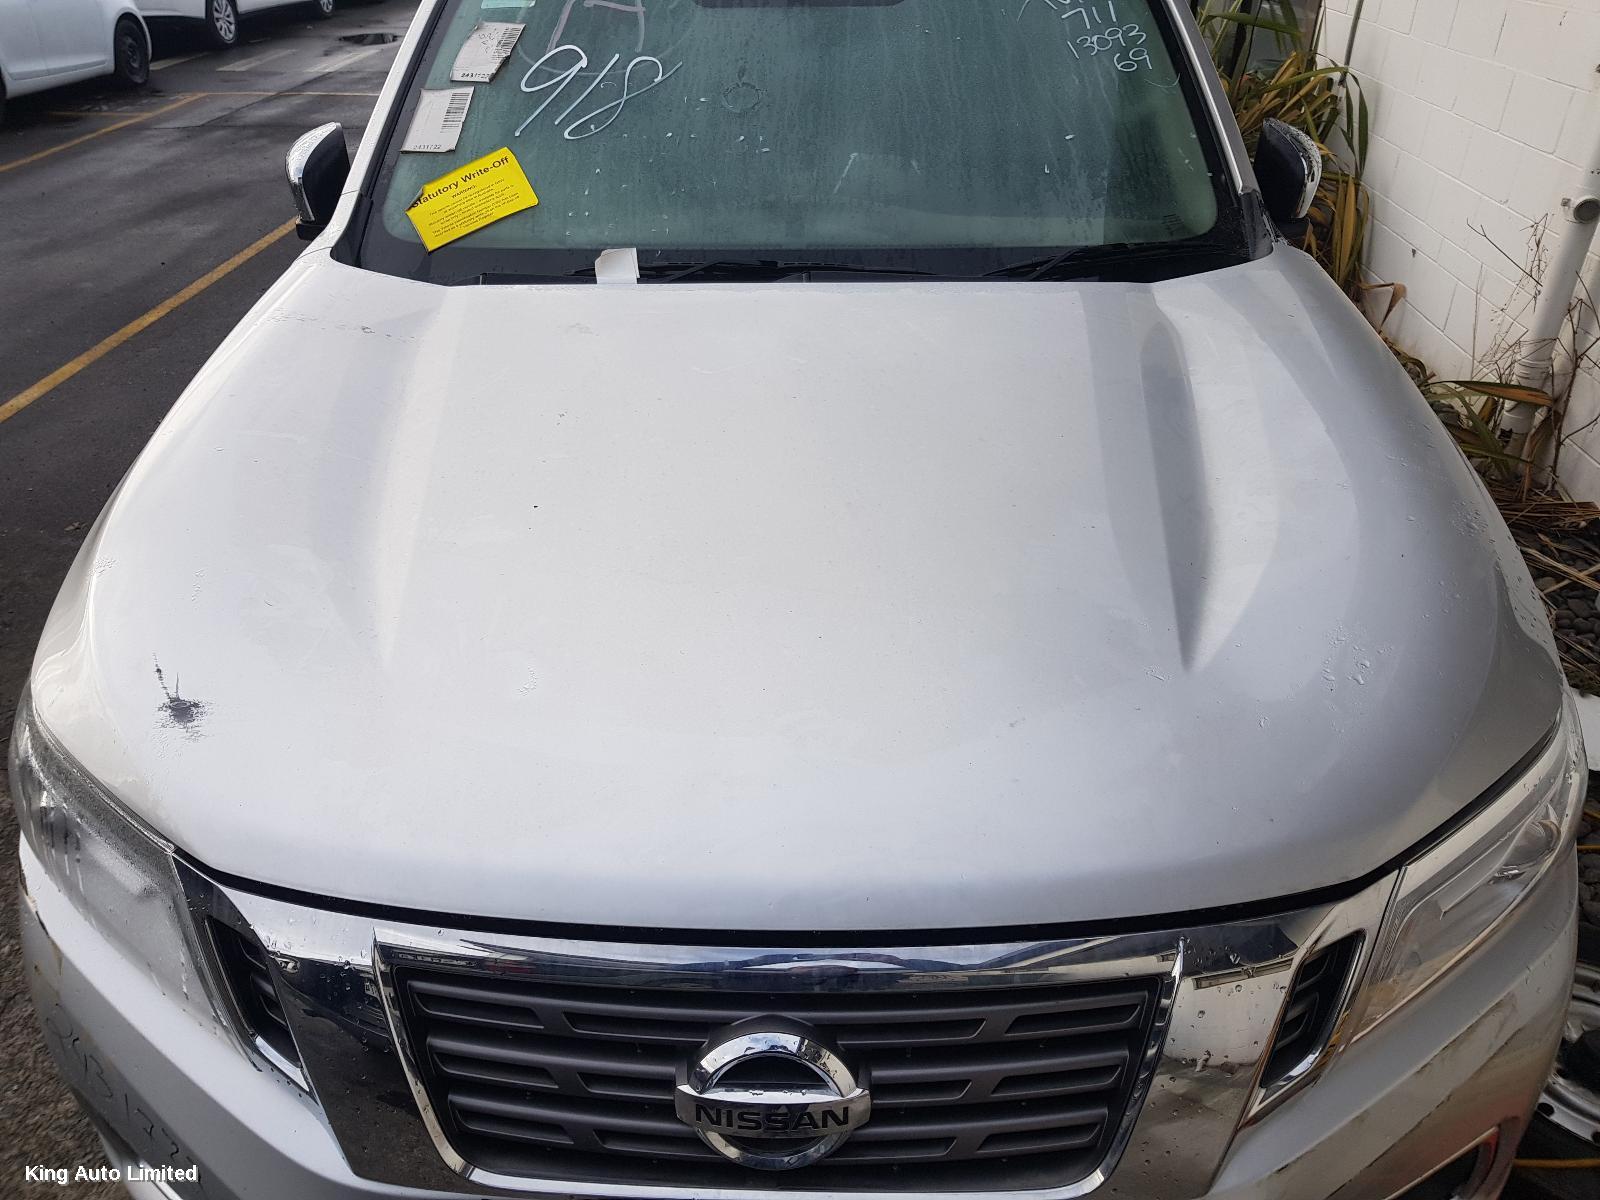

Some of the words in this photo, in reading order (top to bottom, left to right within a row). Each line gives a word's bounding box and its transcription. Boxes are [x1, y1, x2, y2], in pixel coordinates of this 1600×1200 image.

[1067, 24, 1147, 59] 13093
[1113, 47, 1153, 72] 69
[514, 44, 683, 140] 918
[460, 156, 509, 183] Write-Off
[695, 1103, 850, 1132] NISSAN
